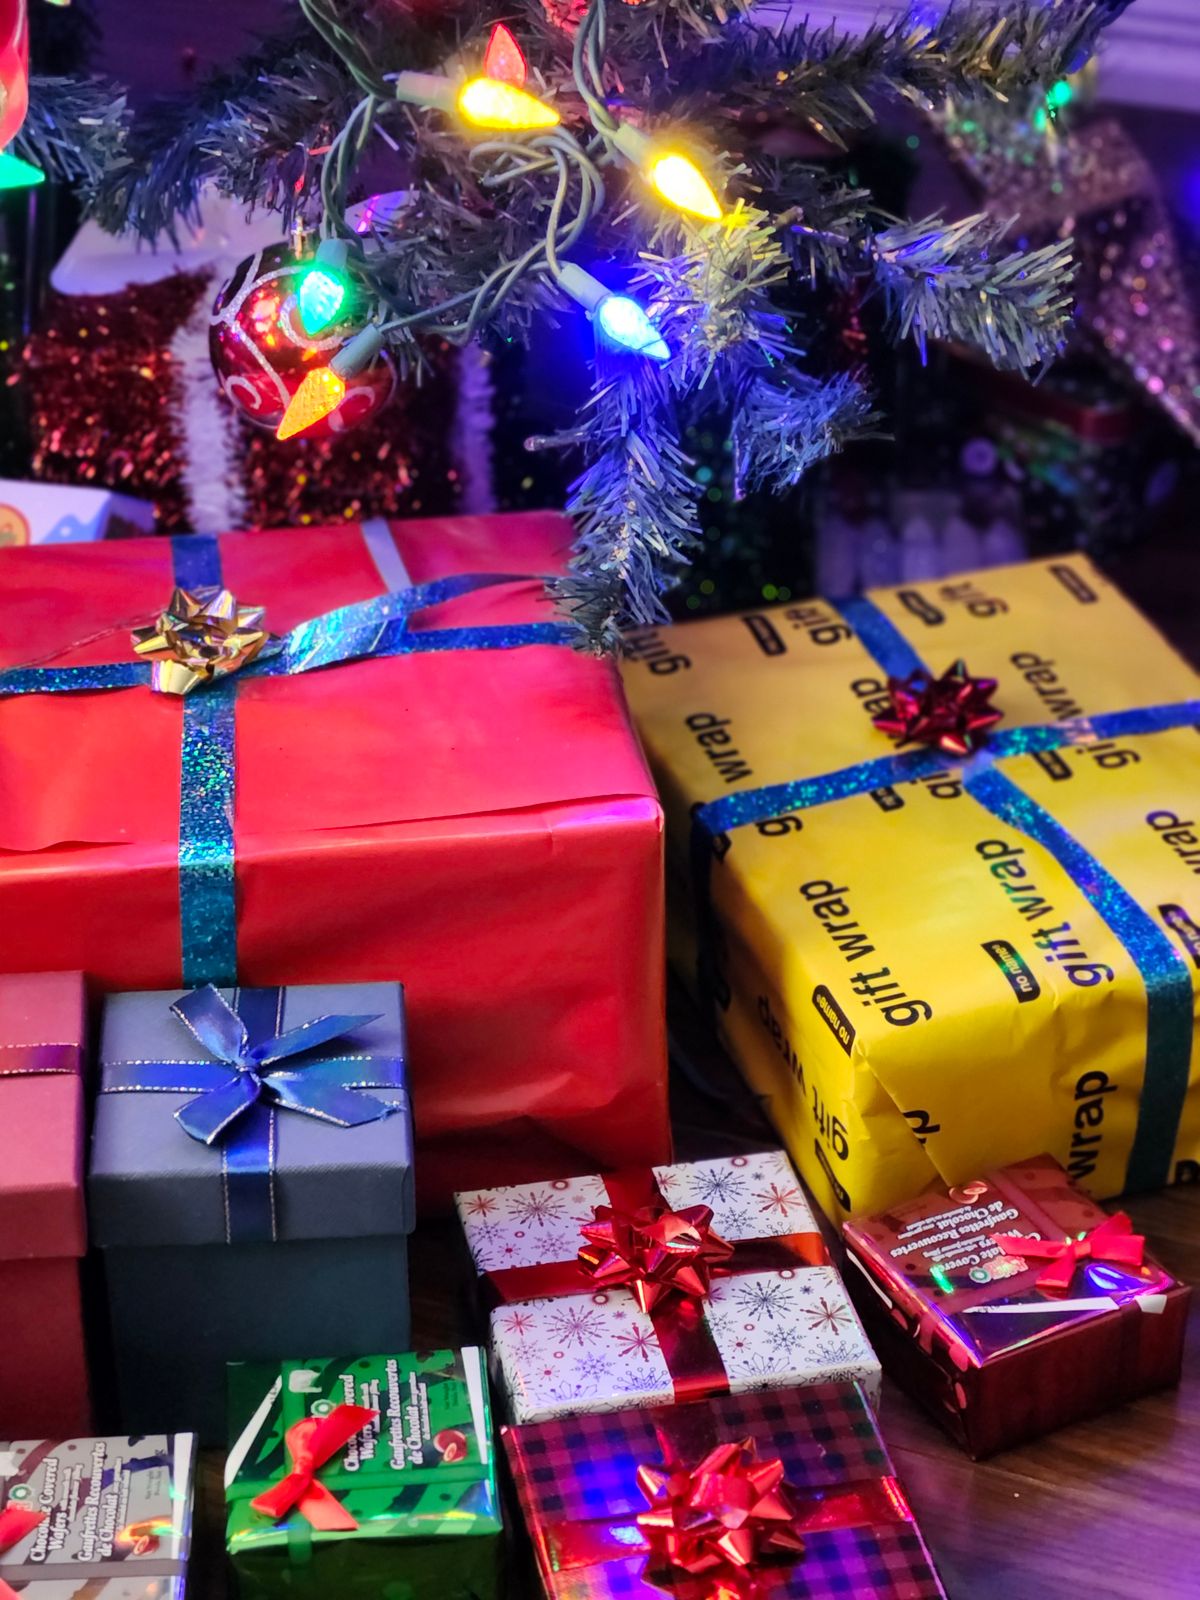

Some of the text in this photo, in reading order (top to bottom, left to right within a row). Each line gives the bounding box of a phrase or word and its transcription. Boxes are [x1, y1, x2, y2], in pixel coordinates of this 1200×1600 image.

[1010, 652, 1083, 721] wrap
[685, 712, 752, 783] wrap
[1075, 742, 1141, 770] gi
[910, 772, 963, 800] gi
[800, 880, 875, 962] wrap
[975, 839, 1114, 987] gift wrap
[850, 967, 933, 1027] gift
[1016, 974, 1033, 993] no
[839, 1026, 851, 1045] no
[811, 1086, 849, 1160] gift
[1067, 1070, 1118, 1180] wrap
[936, 1207, 989, 1230] Chocolat
[958, 1208, 1019, 1234] Gaufrettes
[988, 1200, 1003, 1213] de
[890, 1228, 961, 1257] Recouvertes
[385, 1359, 401, 1417] Recouvertes
[405, 1405, 423, 1451] Chocolat
[407, 1450, 423, 1464] de
[39, 1457, 59, 1504] Covered
[78, 1441, 106, 1561] Gaufrettes Recouvertes
[48, 1512, 70, 1550] Wafers
[99, 1492, 119, 1542] Chocolat
[97, 1543, 113, 1557] de
